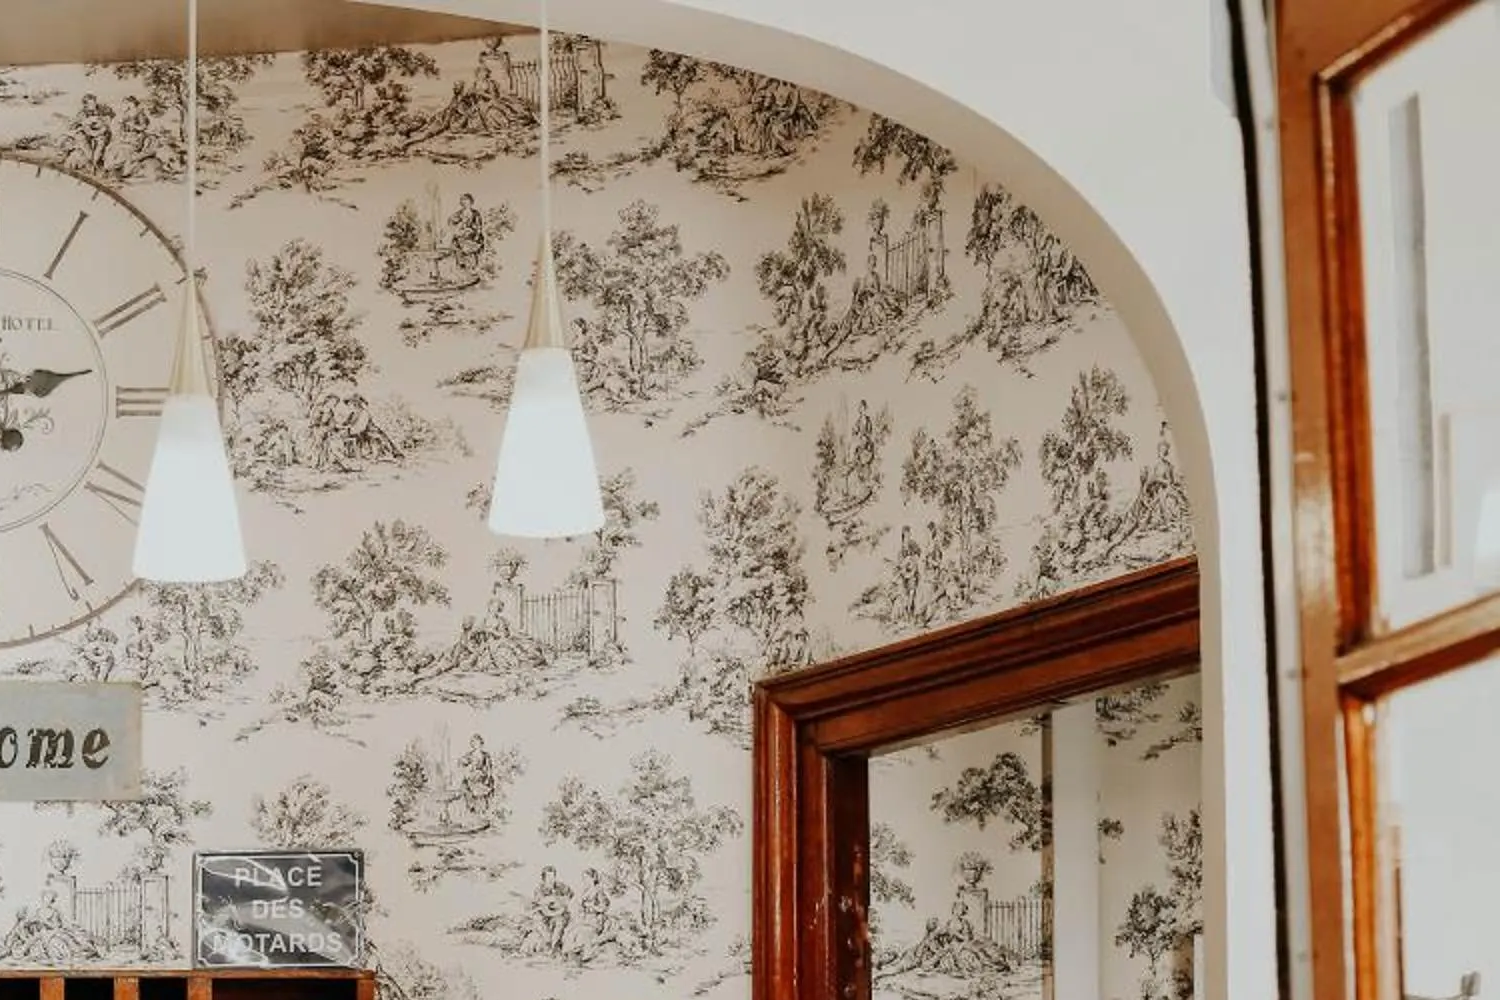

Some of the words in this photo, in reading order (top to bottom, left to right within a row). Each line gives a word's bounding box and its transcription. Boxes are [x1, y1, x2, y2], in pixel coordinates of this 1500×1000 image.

[44, 211, 89, 279] I
[94, 283, 168, 337] II
[234, 865, 323, 887] PLACE
[252, 898, 306, 919] DES
[213, 931, 343, 953] MOTARDS
